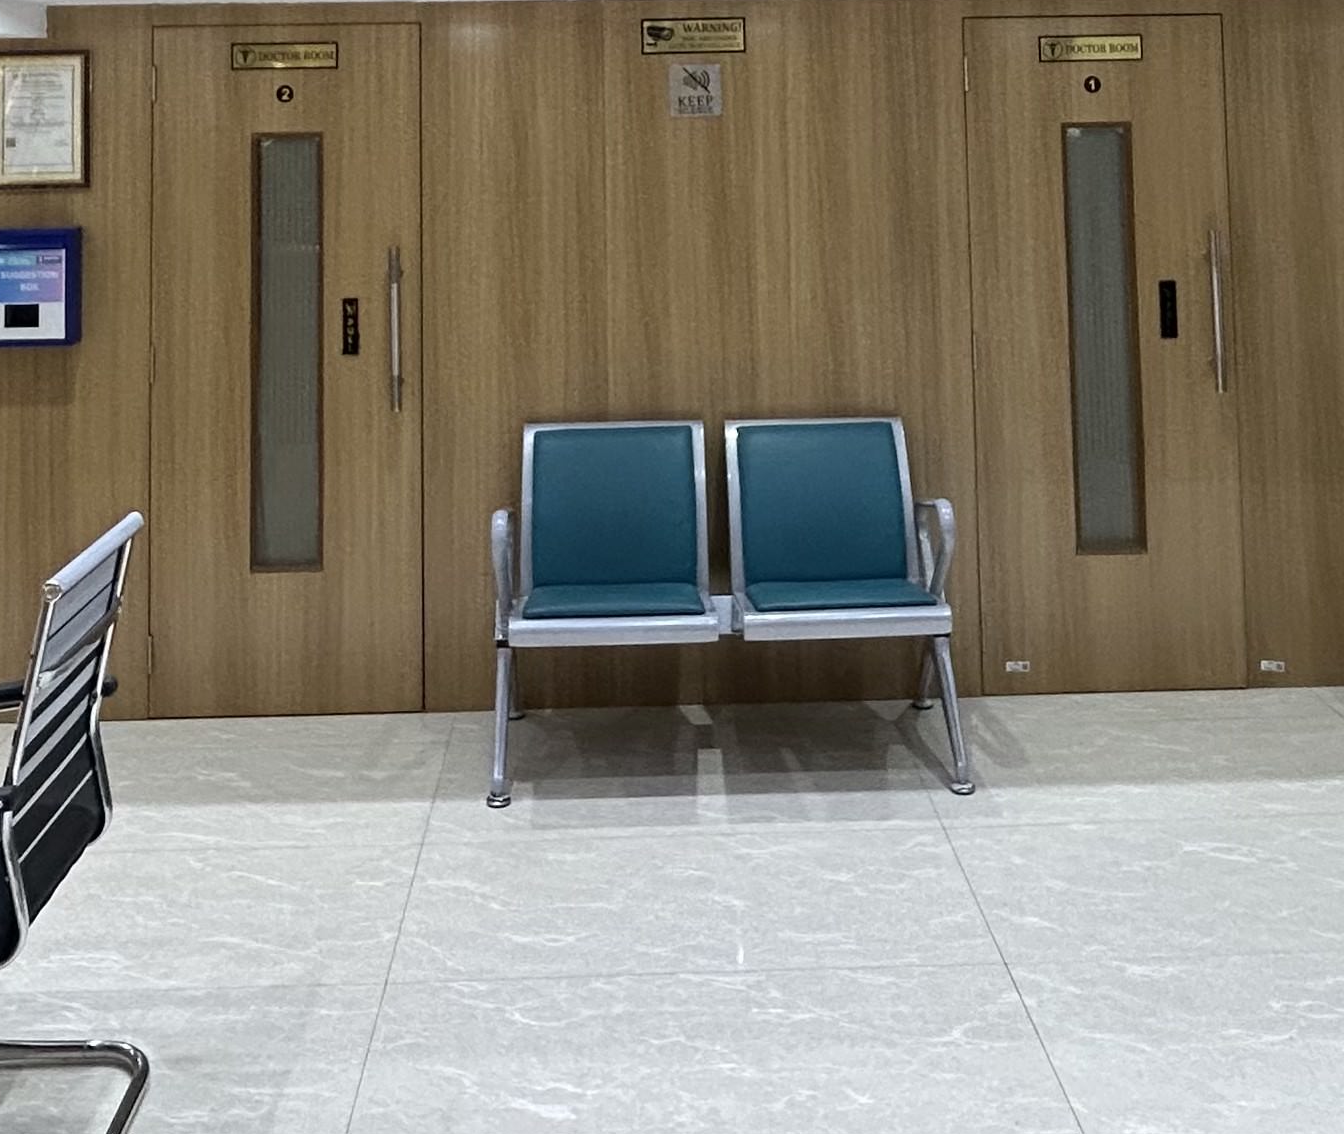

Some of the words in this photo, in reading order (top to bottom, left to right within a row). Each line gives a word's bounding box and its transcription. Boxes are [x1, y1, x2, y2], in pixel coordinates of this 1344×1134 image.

[1065, 42, 1107, 54] DOCTOR
[1109, 42, 1139, 53] ROOM
[258, 50, 301, 61] DOCTOR
[303, 50, 334, 60] ROOM
[280, 88, 290, 100] 2
[678, 95, 714, 107] KEEP
